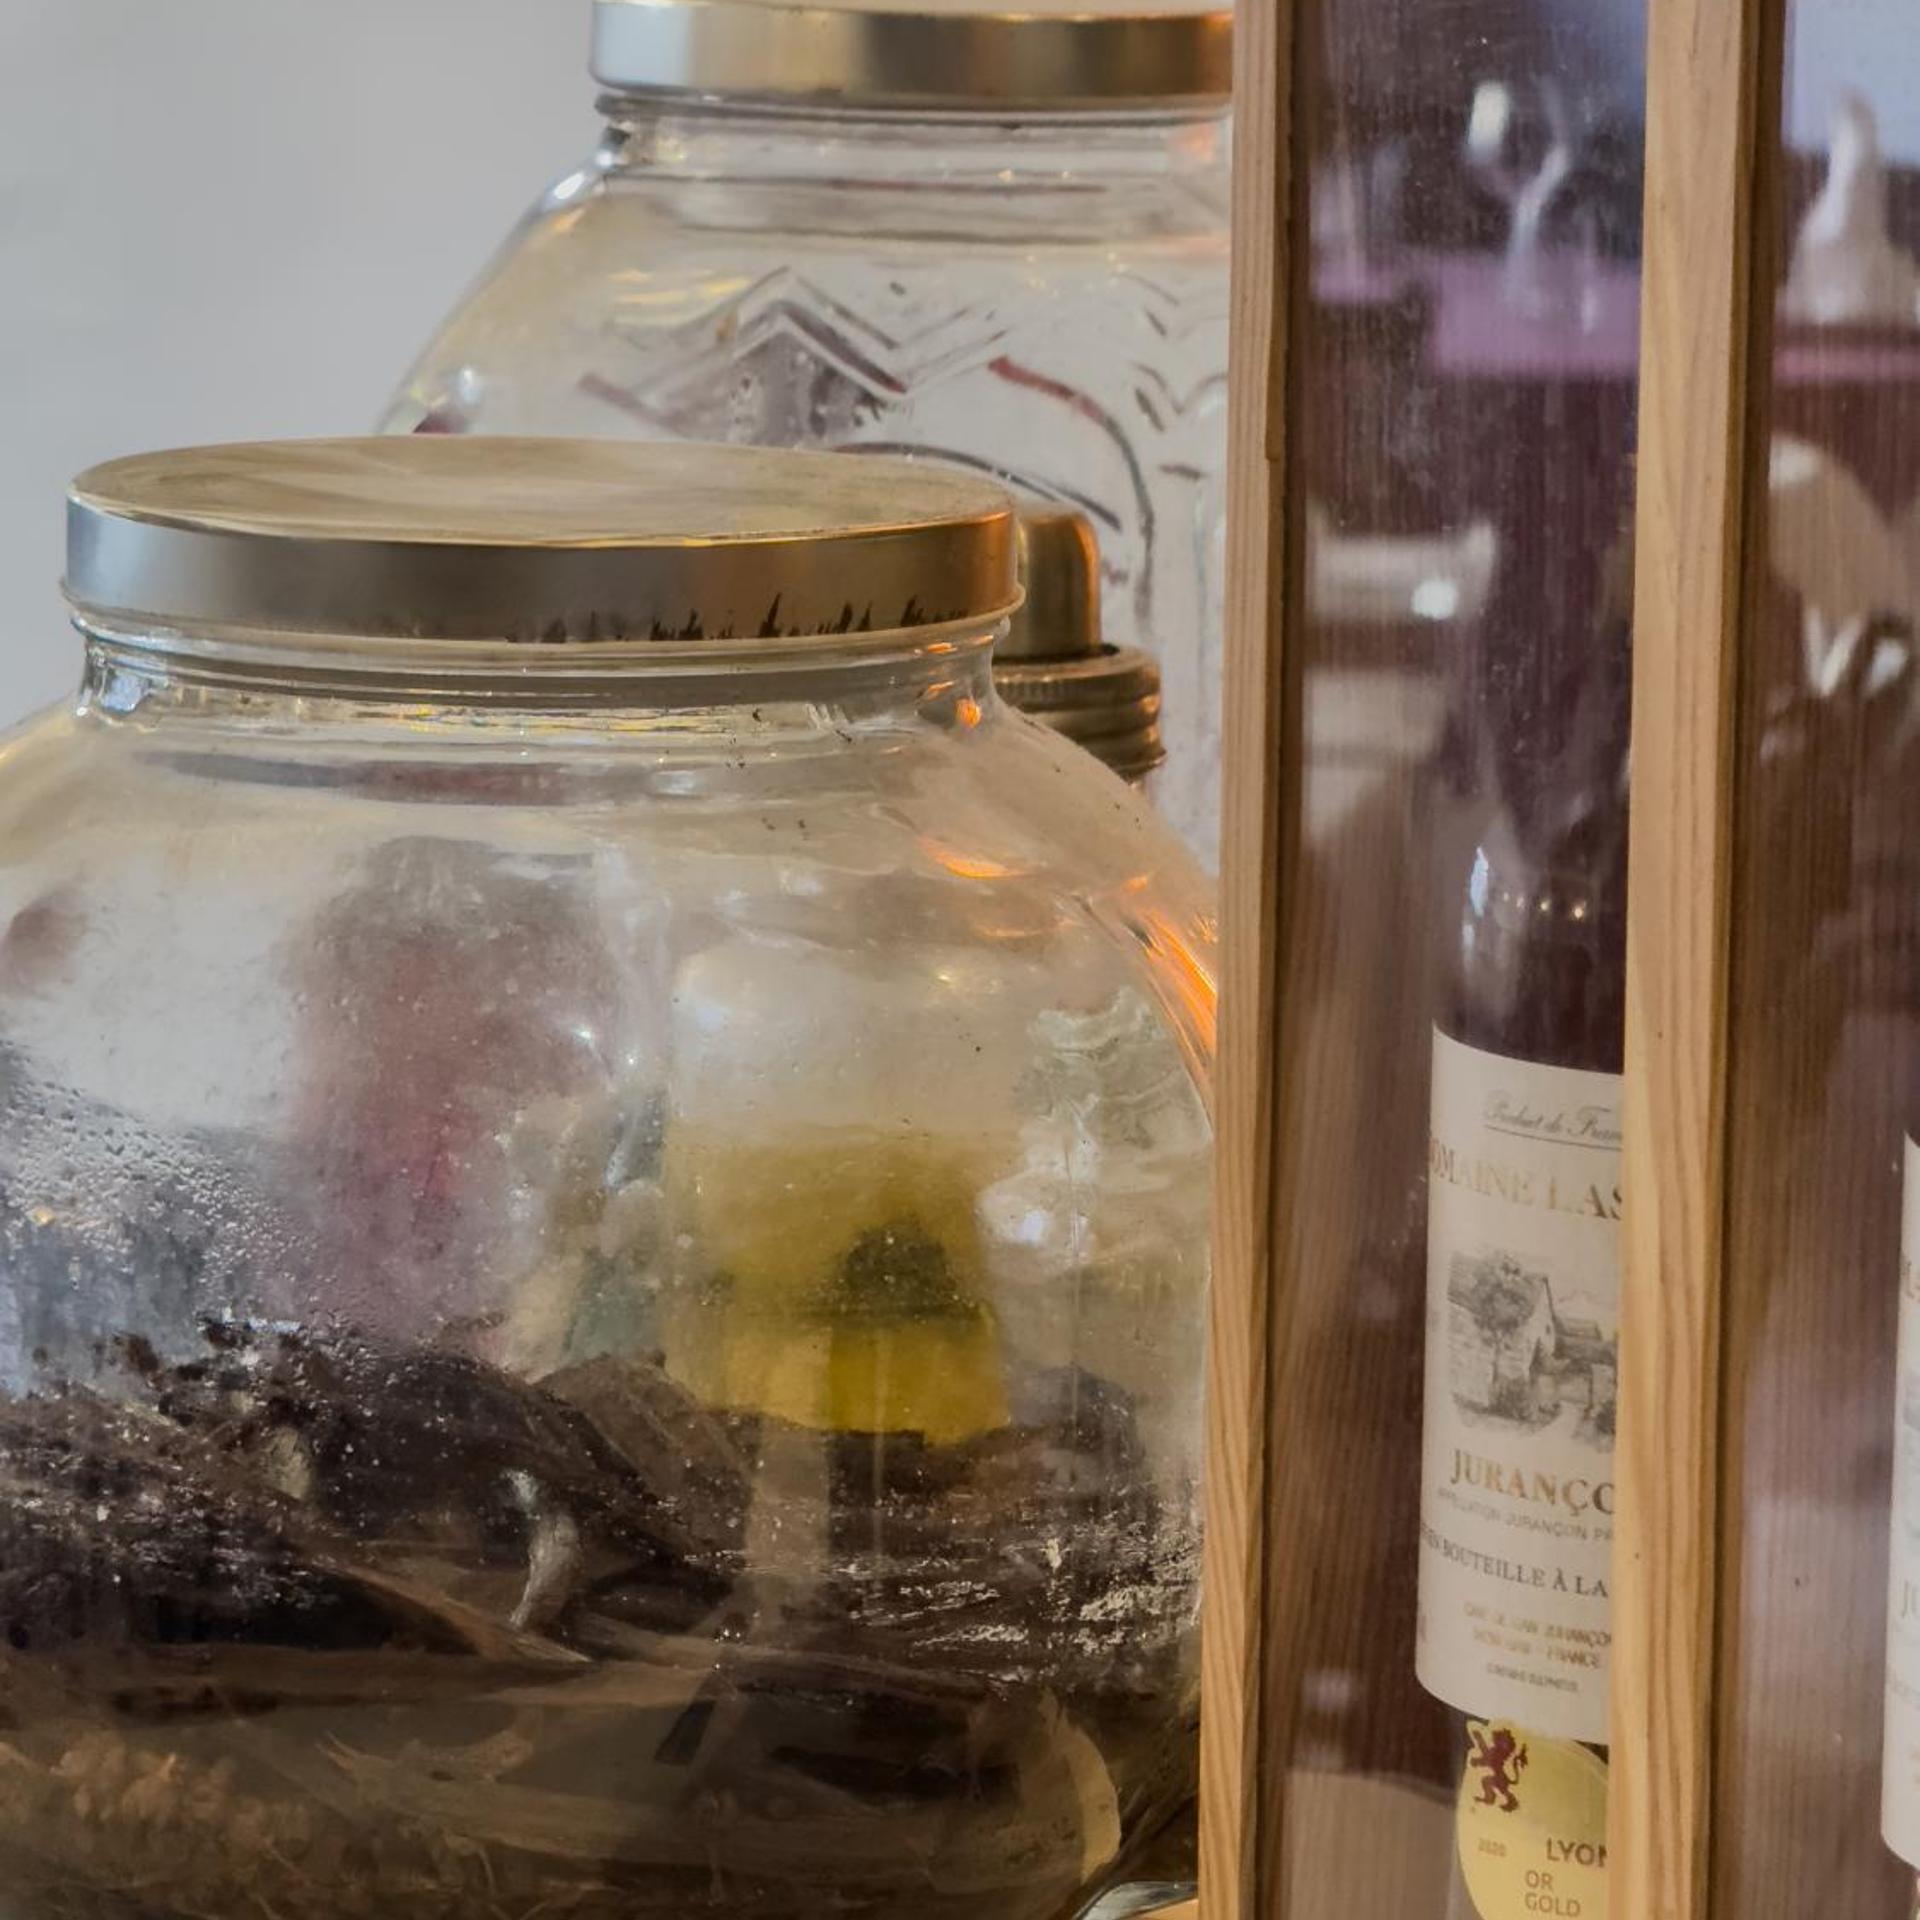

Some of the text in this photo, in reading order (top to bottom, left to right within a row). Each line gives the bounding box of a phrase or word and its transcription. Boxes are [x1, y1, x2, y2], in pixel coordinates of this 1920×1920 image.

[1443, 1538, 1546, 1588] BOUTEILLE
[1576, 1576, 1609, 1598] LA
[1525, 1870, 1554, 1891] OR
[1524, 1893, 1581, 1917] GOLD
